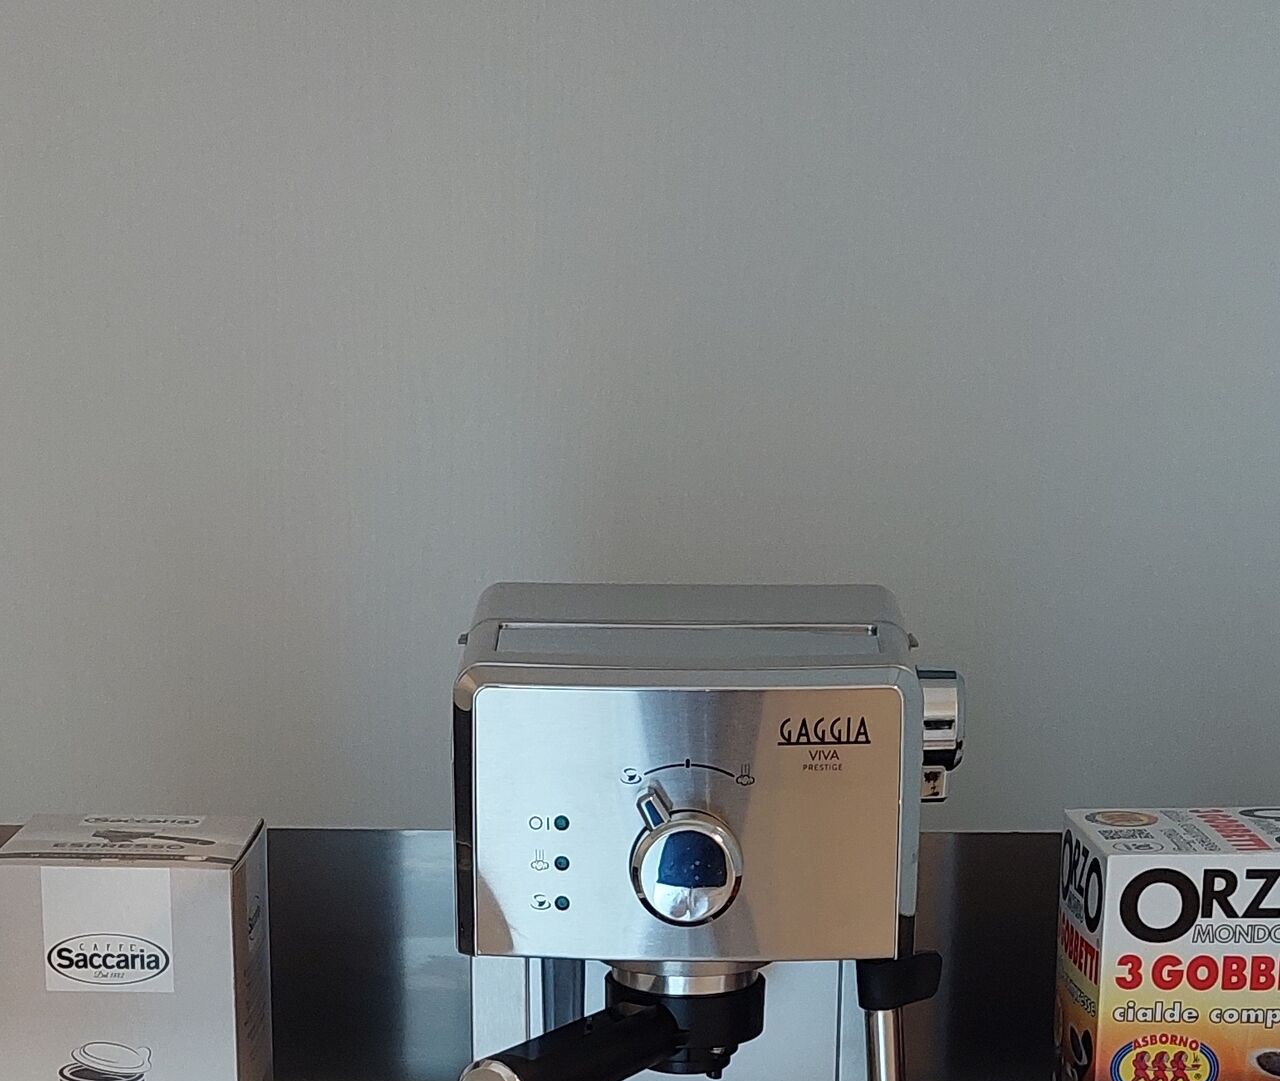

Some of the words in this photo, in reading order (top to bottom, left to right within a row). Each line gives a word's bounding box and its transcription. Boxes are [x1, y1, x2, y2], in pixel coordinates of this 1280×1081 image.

[779, 716, 870, 743] GAGGIA
[809, 750, 840, 761] VIVA
[53, 842, 185, 850] ESPRESSO
[1061, 828, 1103, 934] ORZO
[56, 947, 160, 970] Saccaria
[1114, 954, 1142, 991] 3
[1112, 1000, 1199, 1023] cialde
[1131, 1033, 1200, 1051] ASBORNO
